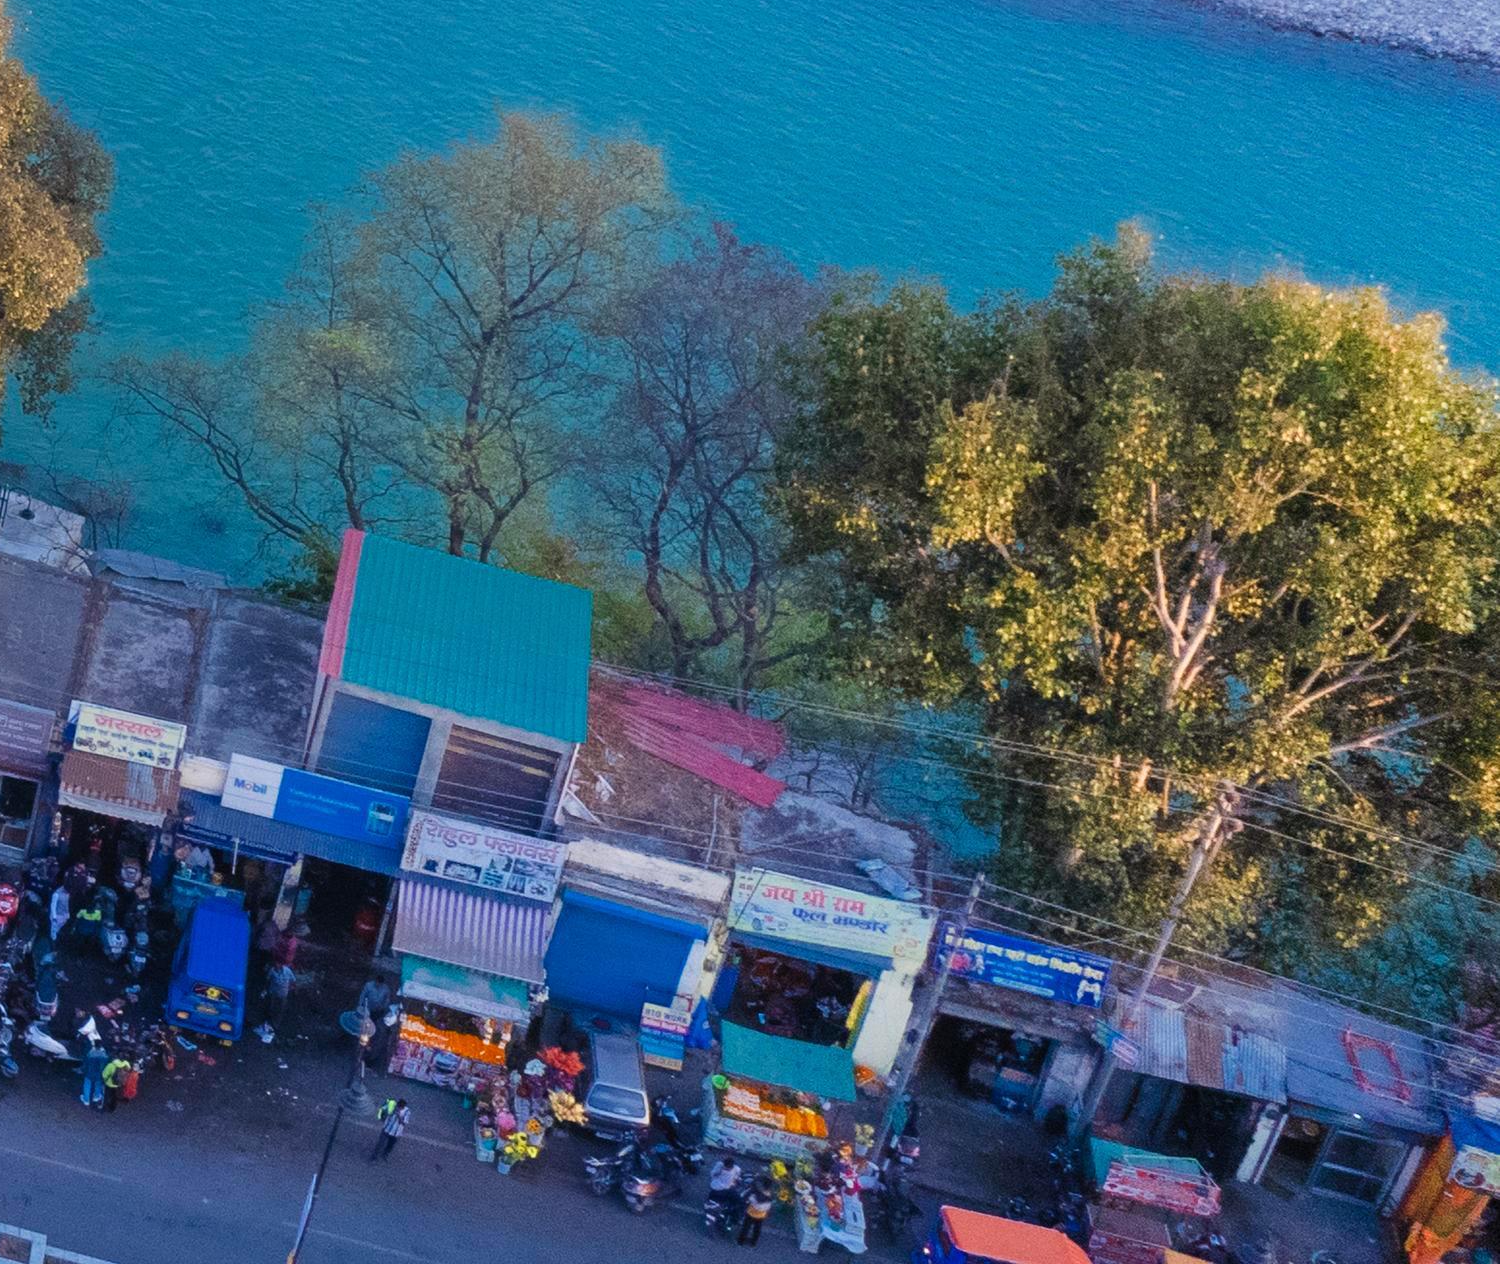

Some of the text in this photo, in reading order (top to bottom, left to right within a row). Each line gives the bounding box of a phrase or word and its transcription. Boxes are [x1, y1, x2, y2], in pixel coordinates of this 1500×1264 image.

[234, 777, 267, 795] Mobil
[762, 885, 867, 916] जय श्री राम
